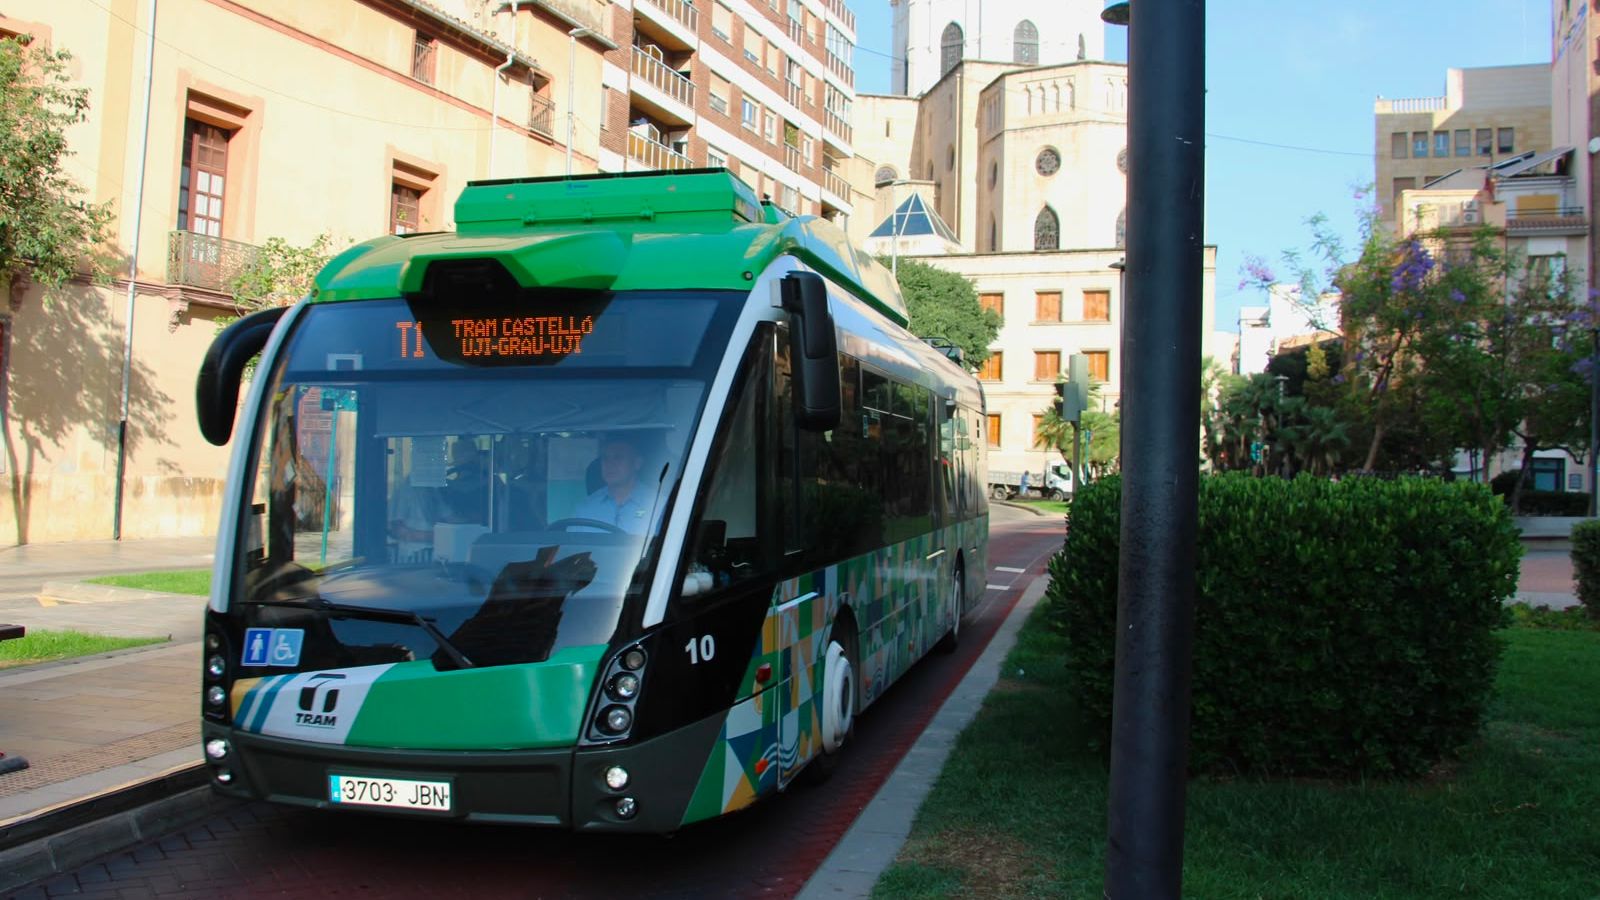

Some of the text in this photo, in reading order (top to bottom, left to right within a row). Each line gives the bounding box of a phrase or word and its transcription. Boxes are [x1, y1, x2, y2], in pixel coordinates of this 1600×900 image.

[396, 321, 425, 357] T1
[451, 315, 594, 338] TRAM CASTELLÓ
[461, 335, 582, 356] UJI-GRAU-UJI
[685, 634, 715, 664] 10
[296, 712, 337, 727] TRAM
[345, 780, 394, 802] 3703
[408, 784, 445, 807] JBN
